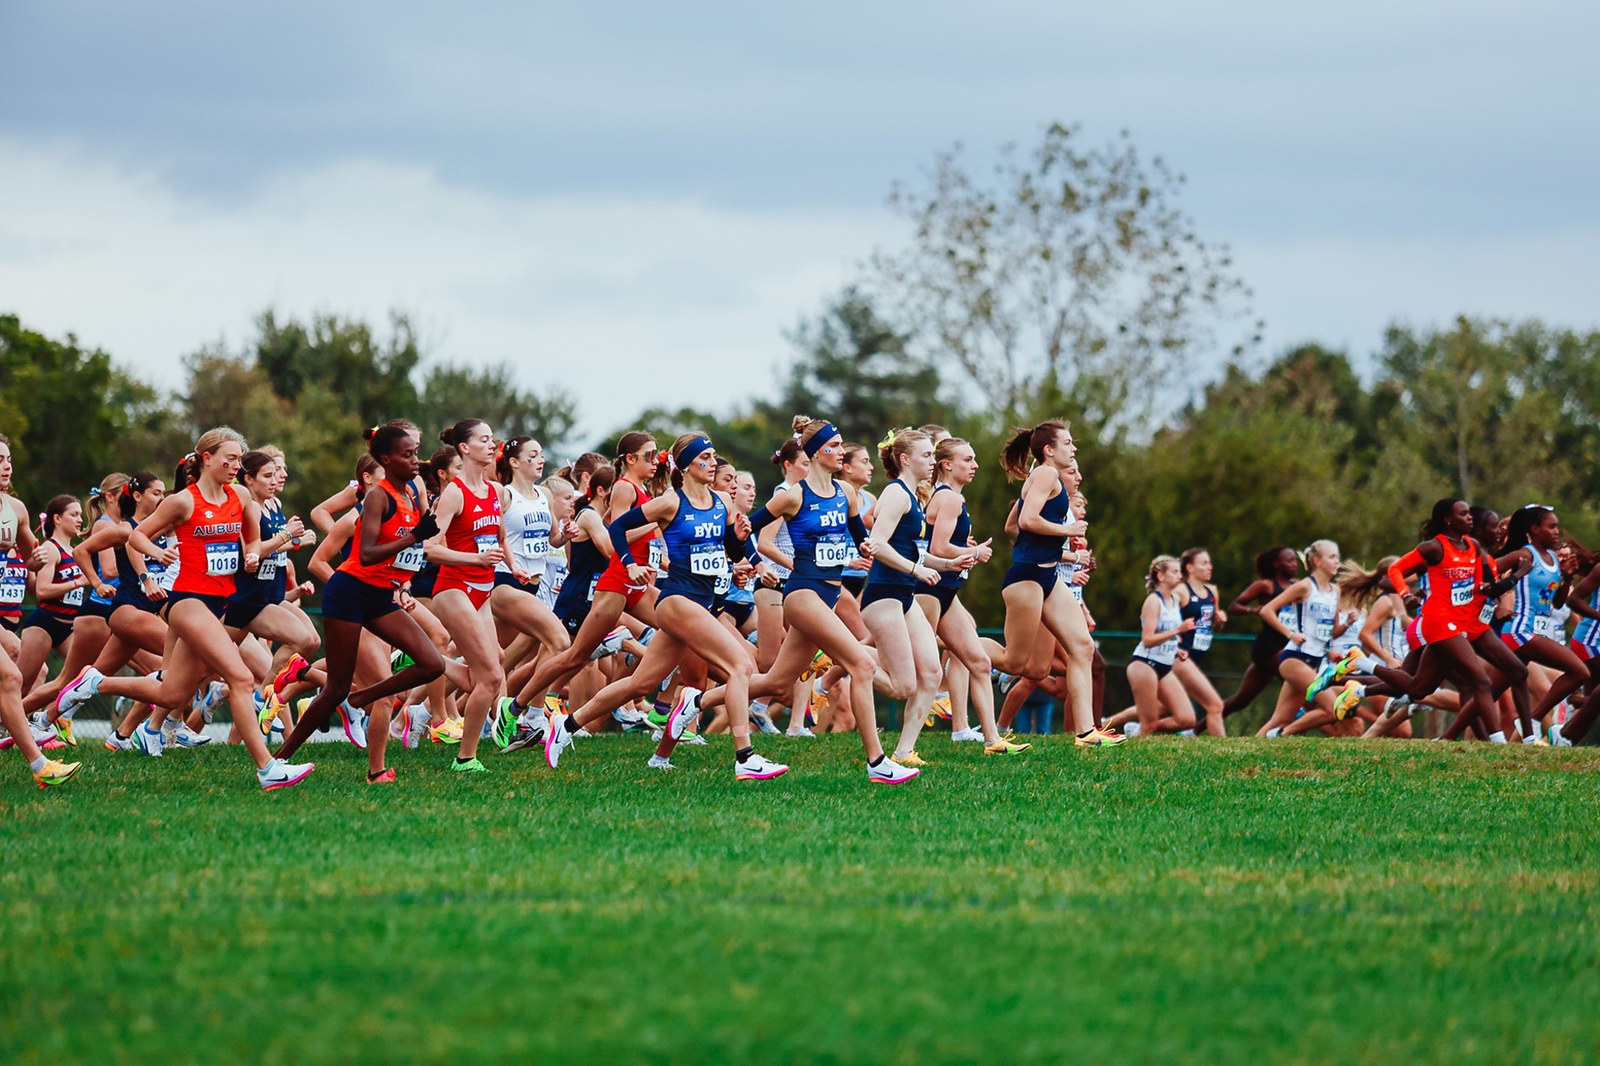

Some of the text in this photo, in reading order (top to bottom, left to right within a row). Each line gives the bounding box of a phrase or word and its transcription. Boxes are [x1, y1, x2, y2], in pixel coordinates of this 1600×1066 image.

[820, 510, 846, 527] BYU
[694, 522, 722, 539] BYU
[210, 557, 237, 571] 1018
[694, 557, 725, 571] 1067
